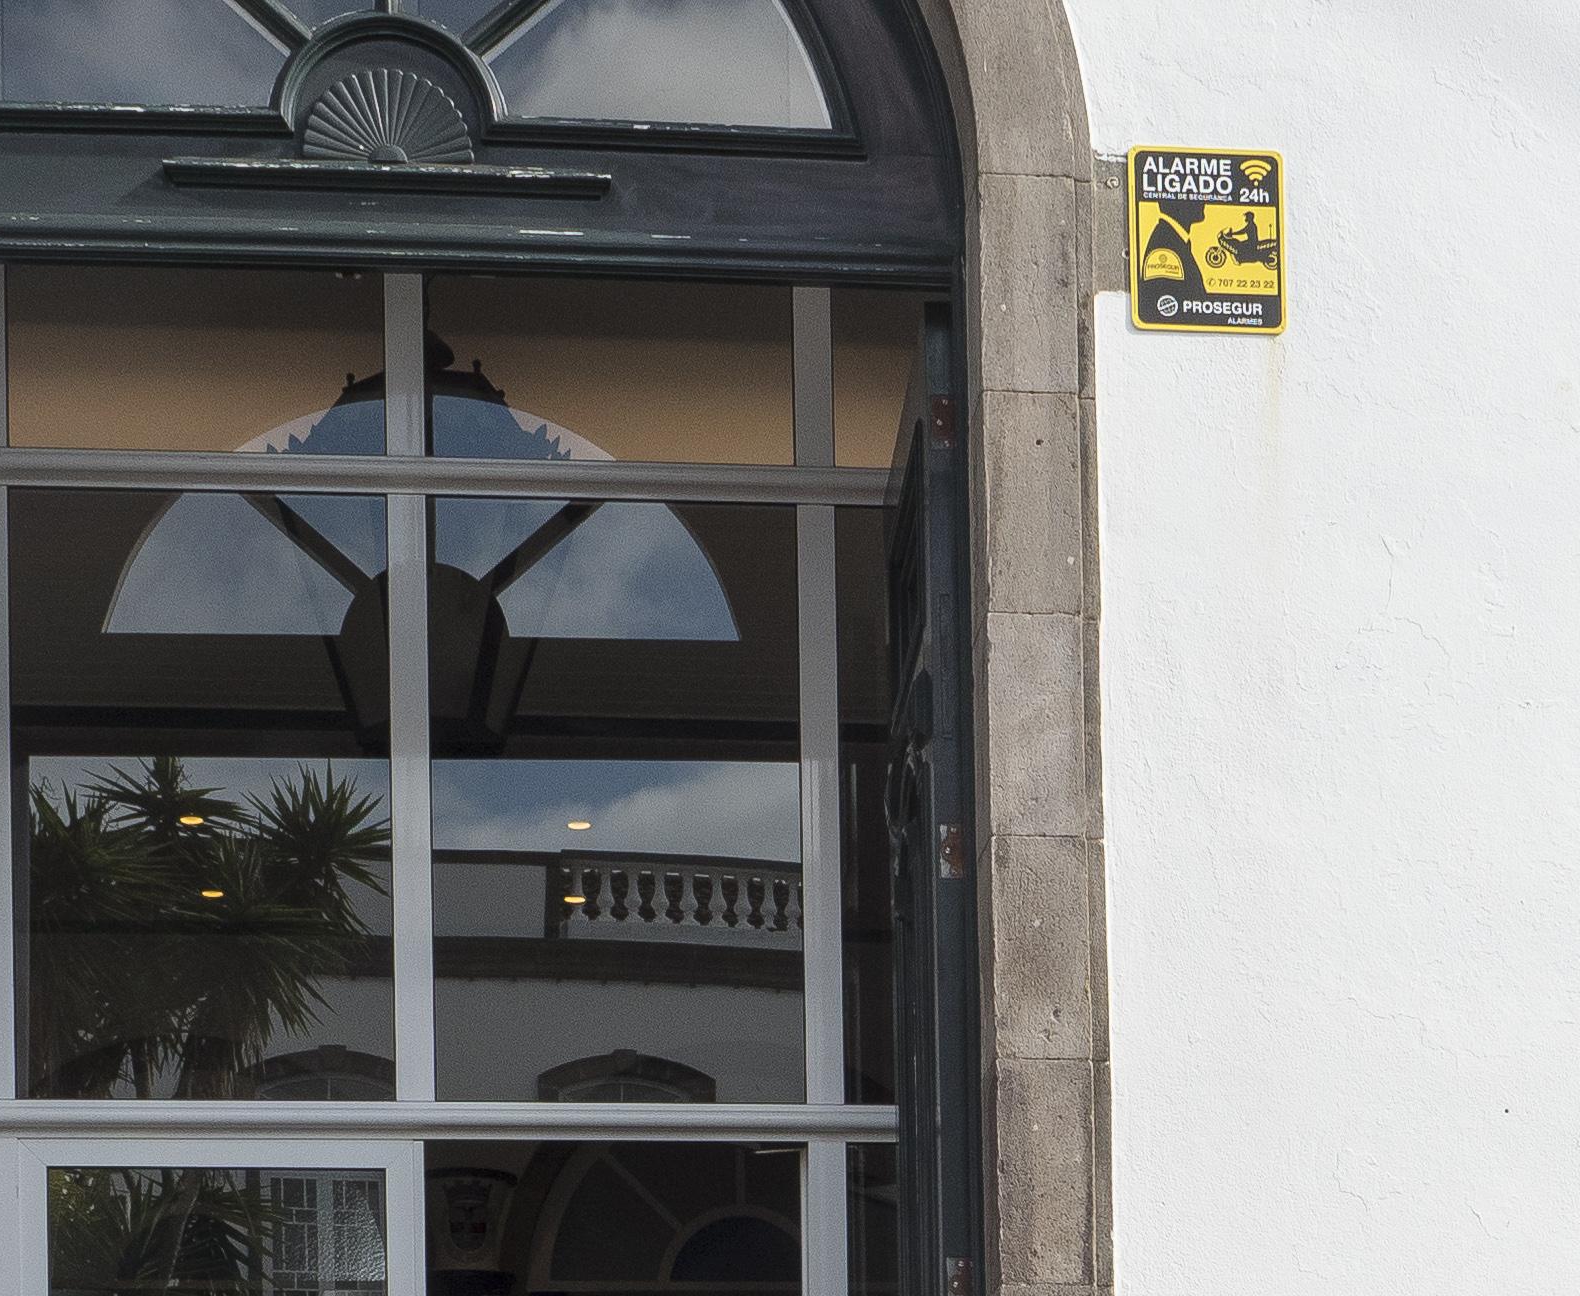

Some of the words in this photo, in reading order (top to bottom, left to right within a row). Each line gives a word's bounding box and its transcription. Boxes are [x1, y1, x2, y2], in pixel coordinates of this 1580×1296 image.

[1143, 156, 1232, 176] ALARME
[1143, 173, 1233, 195] LIGADO
[1239, 188, 1270, 203] 24h
[1218, 279, 1234, 288] 707
[1236, 280, 1248, 288] 22
[1263, 281, 1275, 289] 22
[1182, 301, 1263, 316] PROSEGUR
[1227, 316, 1263, 325] ALARMES
